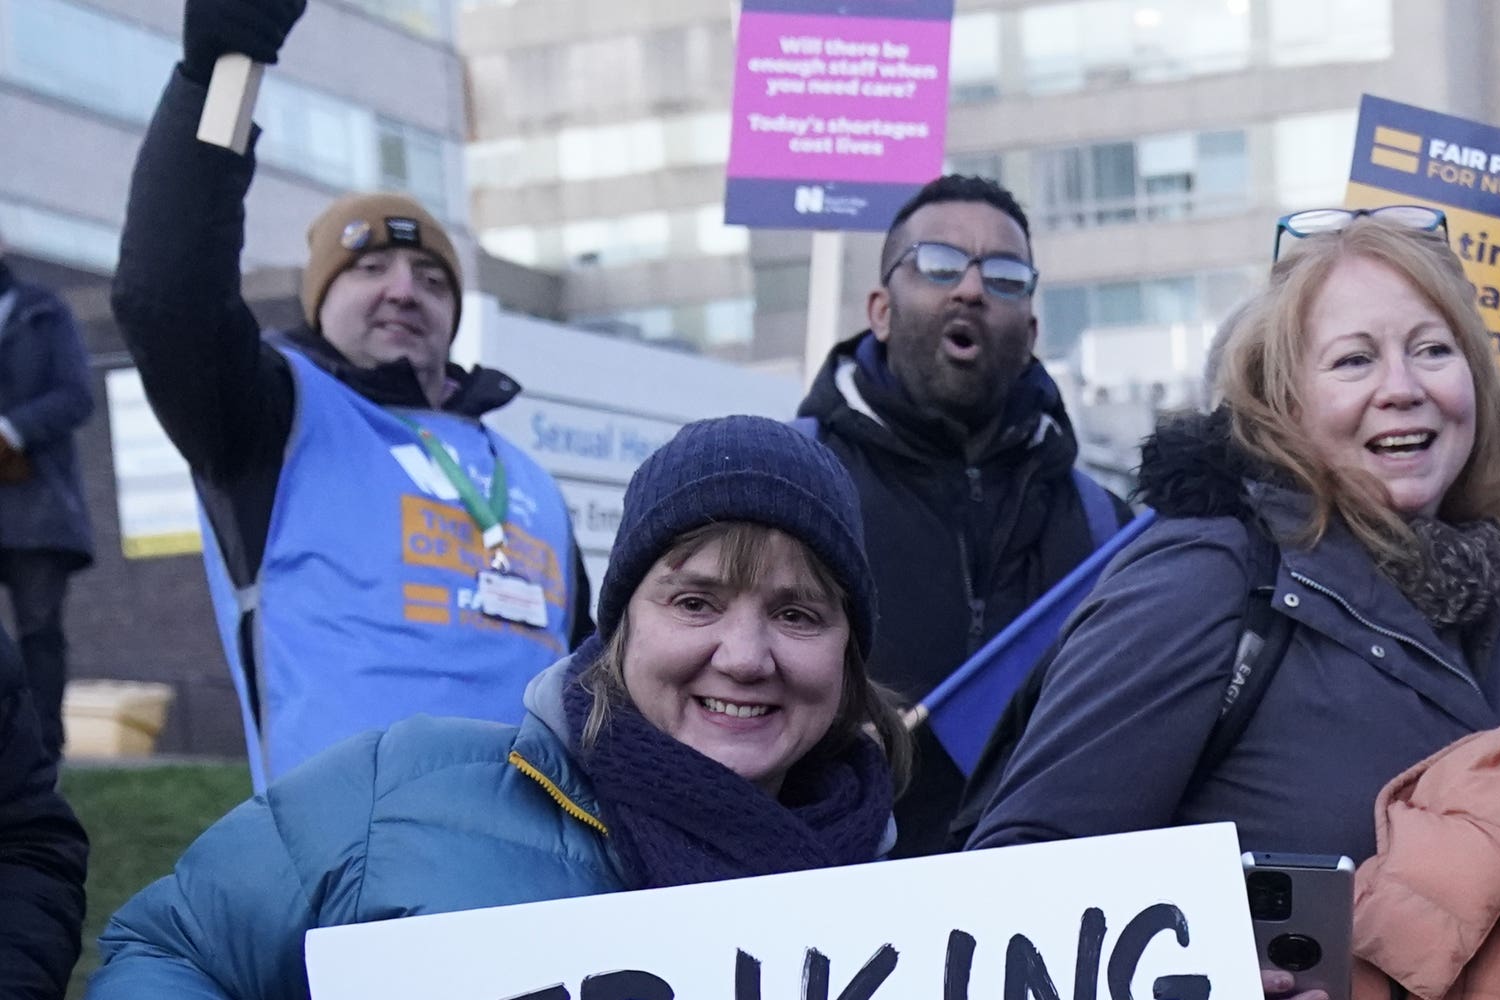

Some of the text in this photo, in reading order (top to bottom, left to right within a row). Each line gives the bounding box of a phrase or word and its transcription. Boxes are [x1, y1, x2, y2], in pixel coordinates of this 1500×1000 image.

[779, 36, 823, 55] Will
[747, 58, 938, 80] enough staff when
[765, 78, 917, 98] you need care?
[747, 113, 929, 141] Today's shortages
[788, 137, 885, 156] cost lives
[1428, 138, 1488, 172] FAIR
[1426, 160, 1477, 189] FOR
